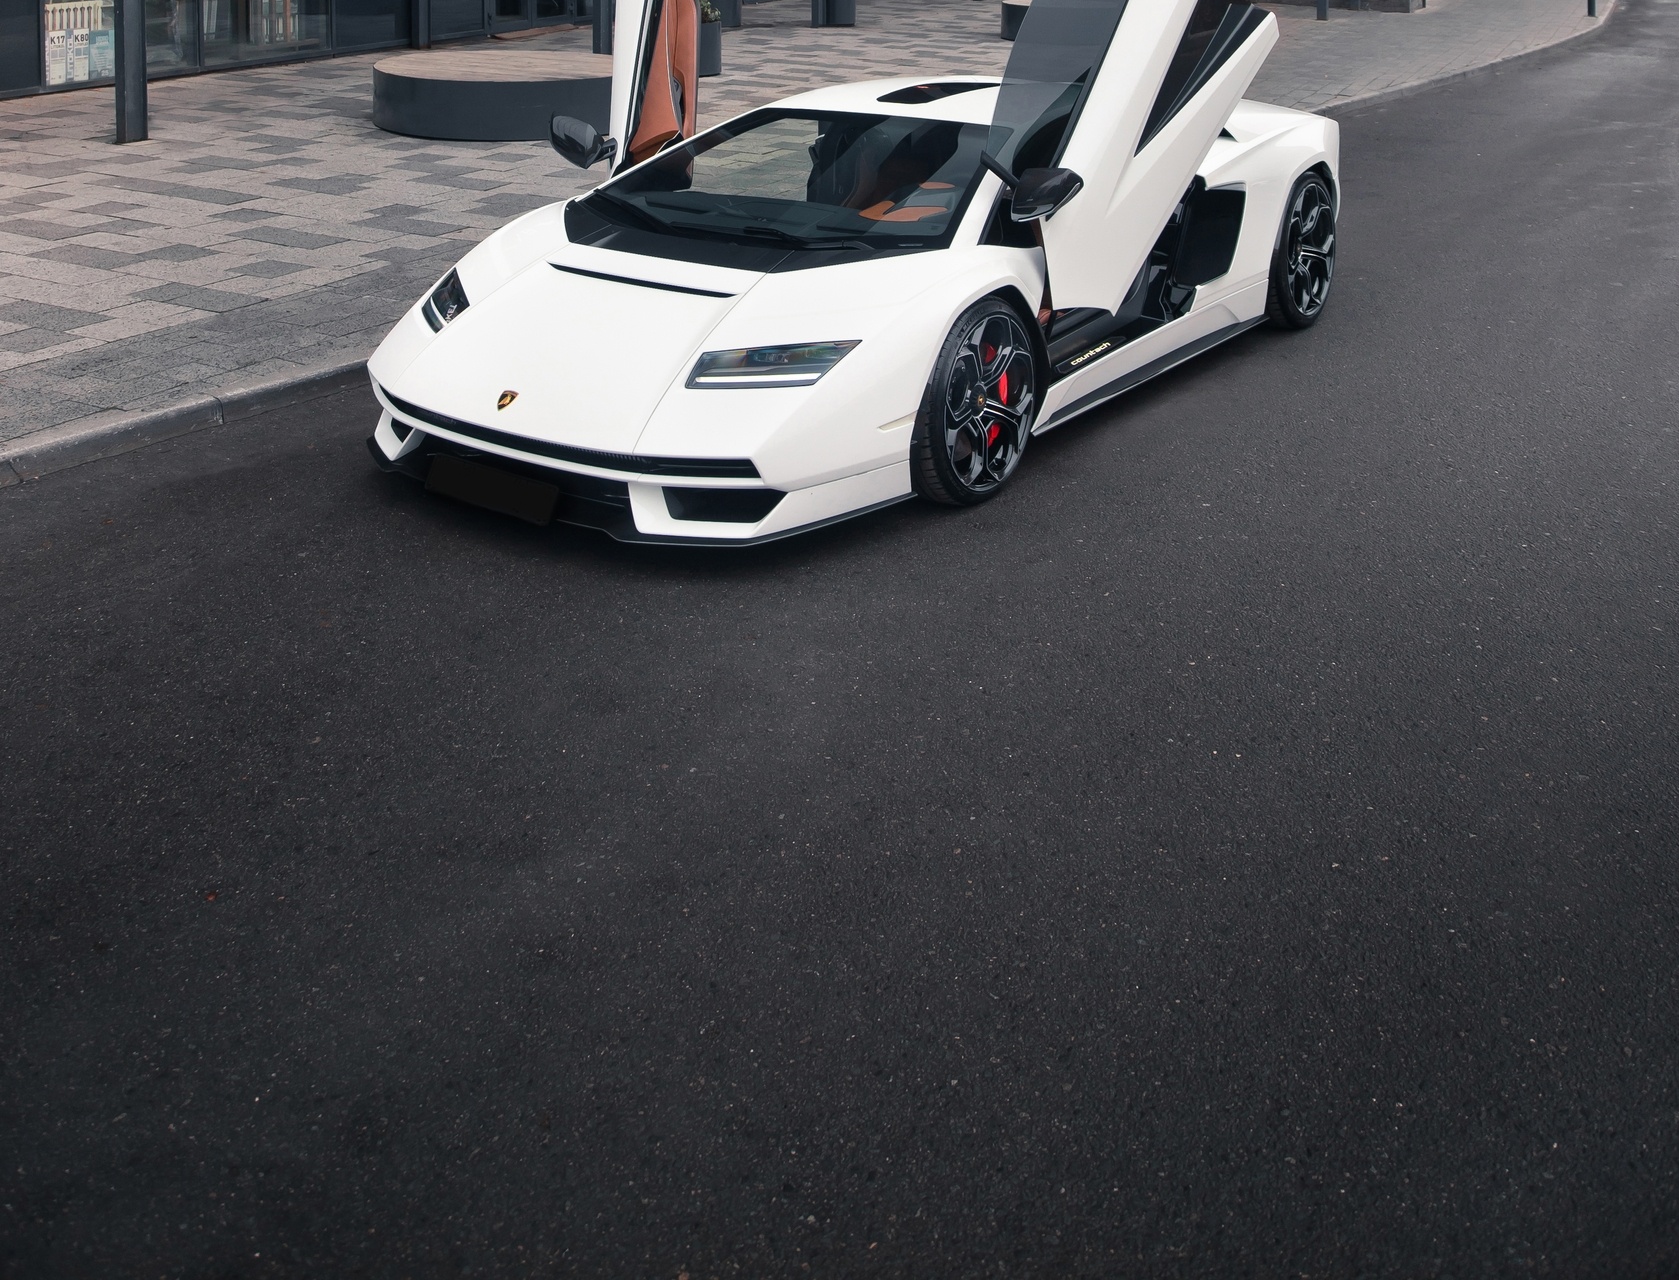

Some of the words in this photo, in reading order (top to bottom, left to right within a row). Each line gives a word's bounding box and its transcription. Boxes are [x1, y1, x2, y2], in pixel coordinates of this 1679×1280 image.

[50, 35, 65, 45] K17
[74, 33, 89, 43] K80
[1071, 341, 1111, 366] countach
